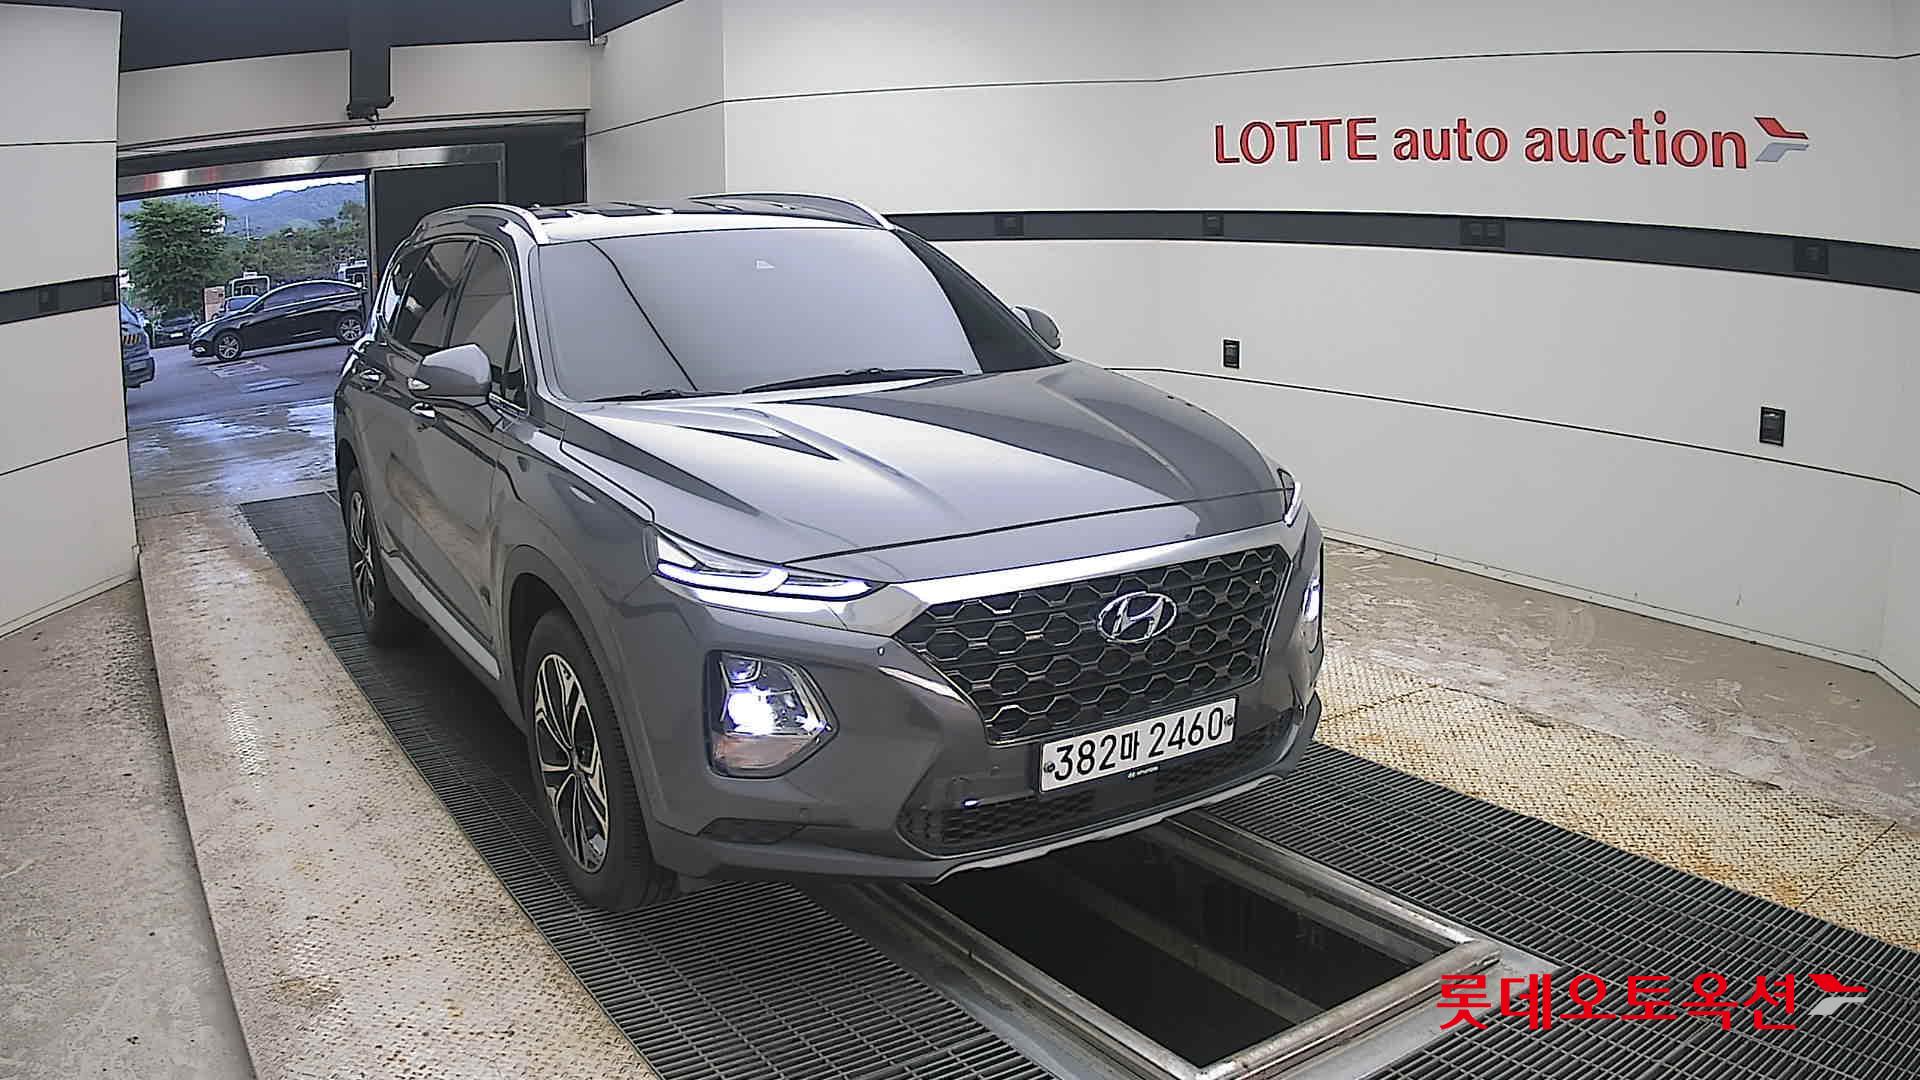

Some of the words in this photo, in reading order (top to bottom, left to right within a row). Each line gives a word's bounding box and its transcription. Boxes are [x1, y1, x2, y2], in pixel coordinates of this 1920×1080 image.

[1214, 117, 1377, 164] LOTTE
[1392, 117, 1508, 162] auto
[1524, 110, 1748, 169] auction
[1054, 728, 1139, 781] 382마
[1148, 707, 1224, 758] 2460
